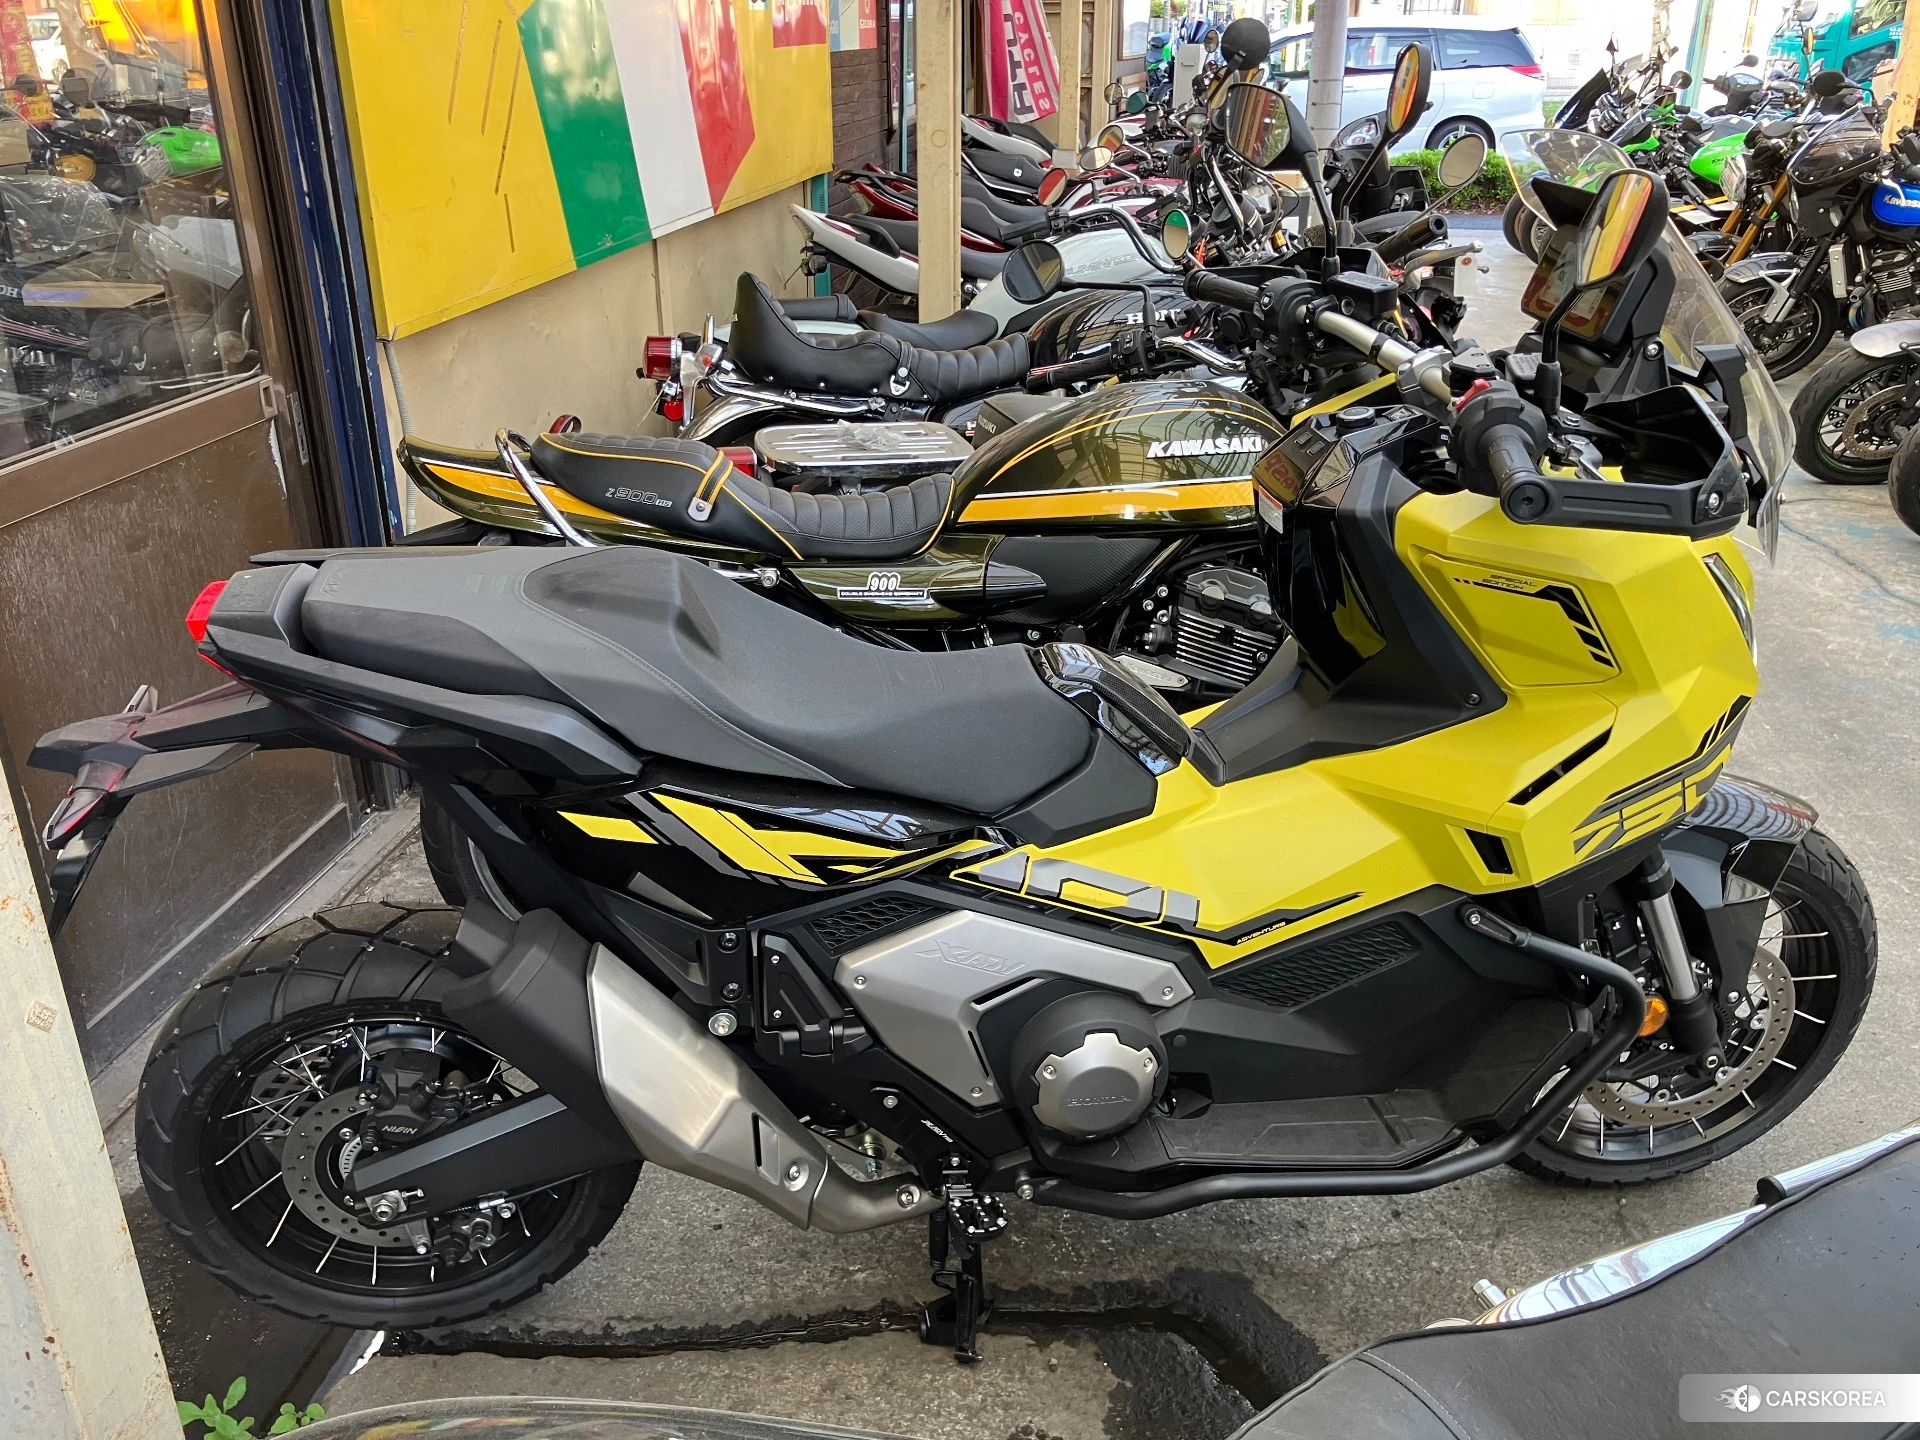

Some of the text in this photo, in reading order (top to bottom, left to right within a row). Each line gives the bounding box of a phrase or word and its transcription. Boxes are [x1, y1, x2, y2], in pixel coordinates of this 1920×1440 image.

[1147, 437, 1261, 458] KAWASAKI
[869, 575, 899, 591] 900
[1482, 578, 1524, 590] EDITION
[1489, 574, 1537, 587] SPECIAL
[1236, 921, 1286, 944] ADVENTURE
[1067, 1095, 1132, 1107] HONDA
